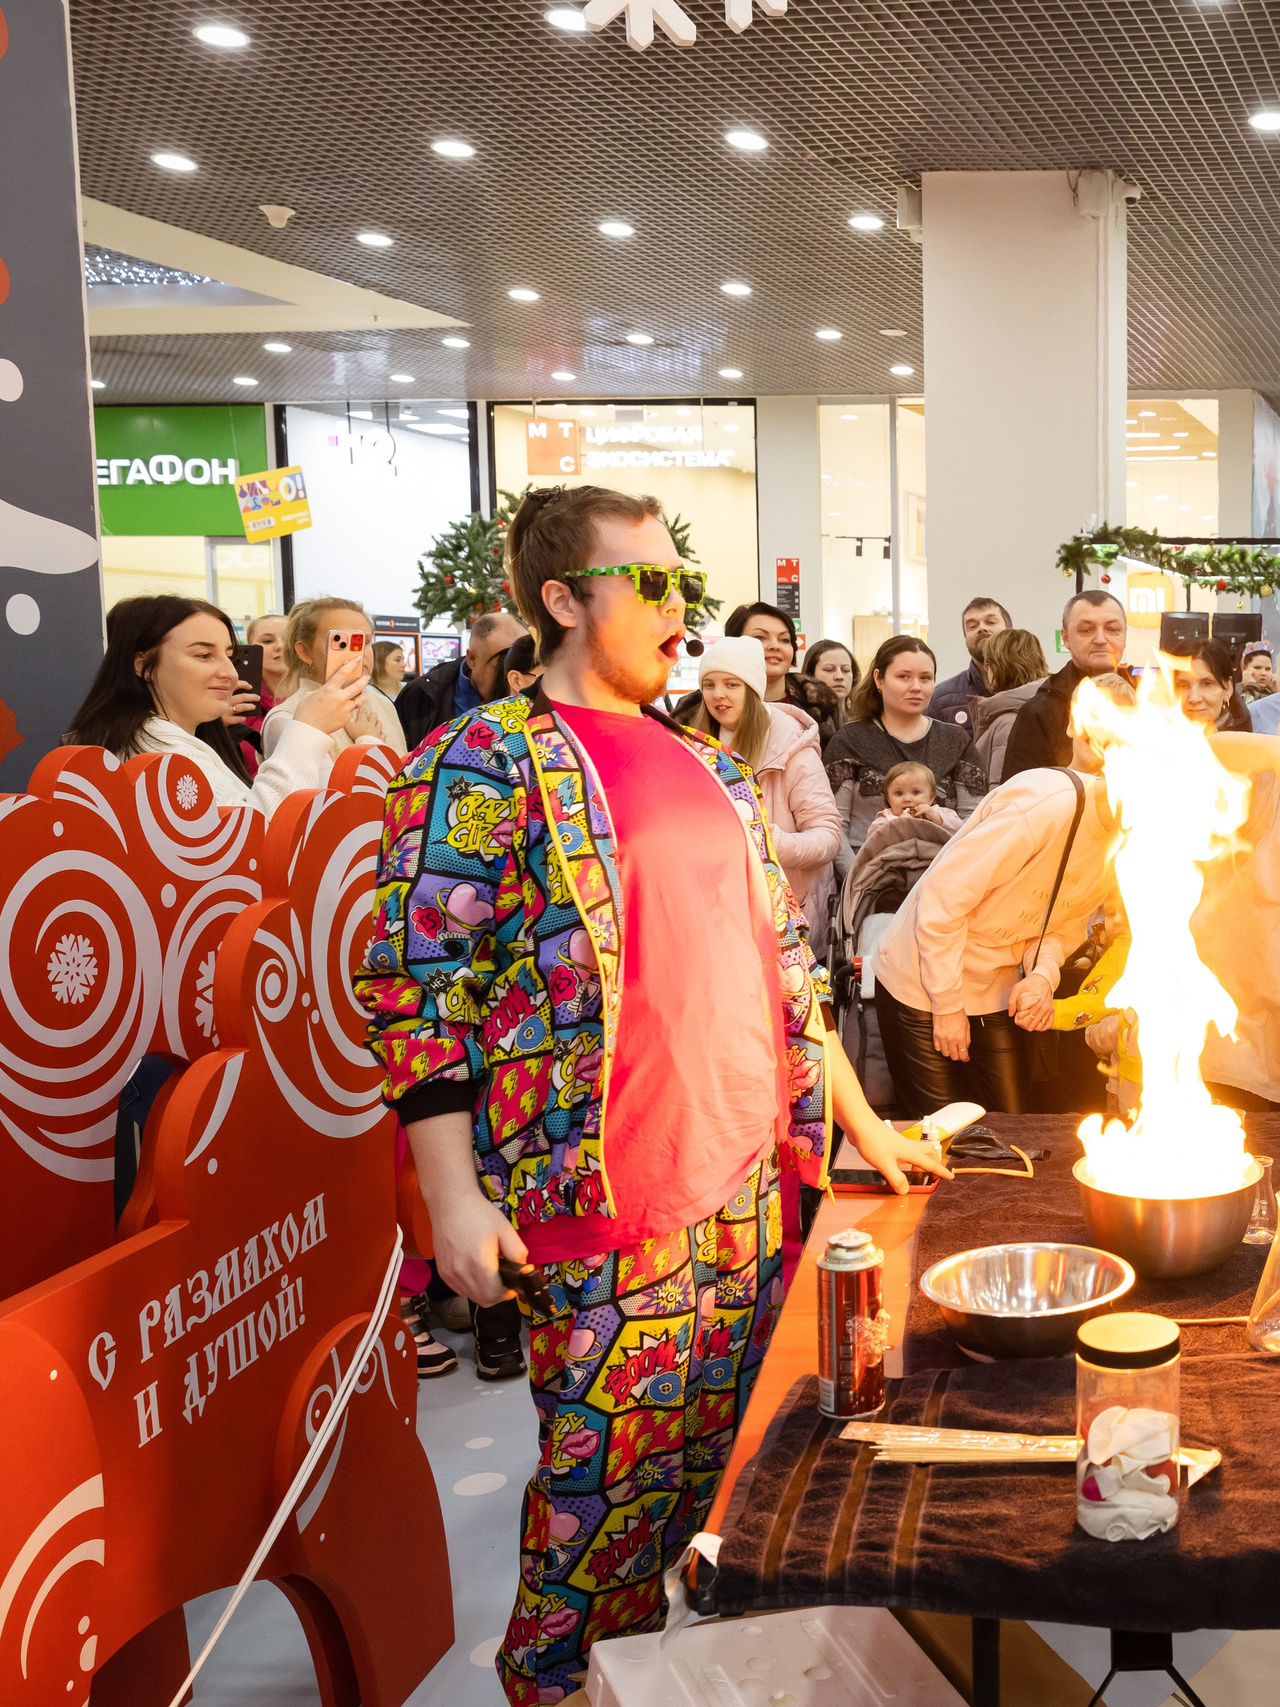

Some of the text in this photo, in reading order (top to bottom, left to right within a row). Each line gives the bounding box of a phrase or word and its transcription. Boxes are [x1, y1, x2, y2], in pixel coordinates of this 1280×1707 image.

[469, 726, 495, 743] YES
[536, 749, 557, 760] OW
[452, 782, 467, 795] HEY
[418, 912, 437, 930] ES
[592, 926, 610, 941] OW
[430, 975, 448, 990] HEY
[88, 1193, 328, 1391] С РАЗМАХОМ
[657, 1288, 684, 1304] WOW
[716, 1280, 746, 1298] WOW
[133, 1274, 307, 1448] И ДУШОЙ!
[604, 1335, 680, 1405] BOOM
[636, 1469, 666, 1481] WOW
[584, 1510, 652, 1584] BOOM
